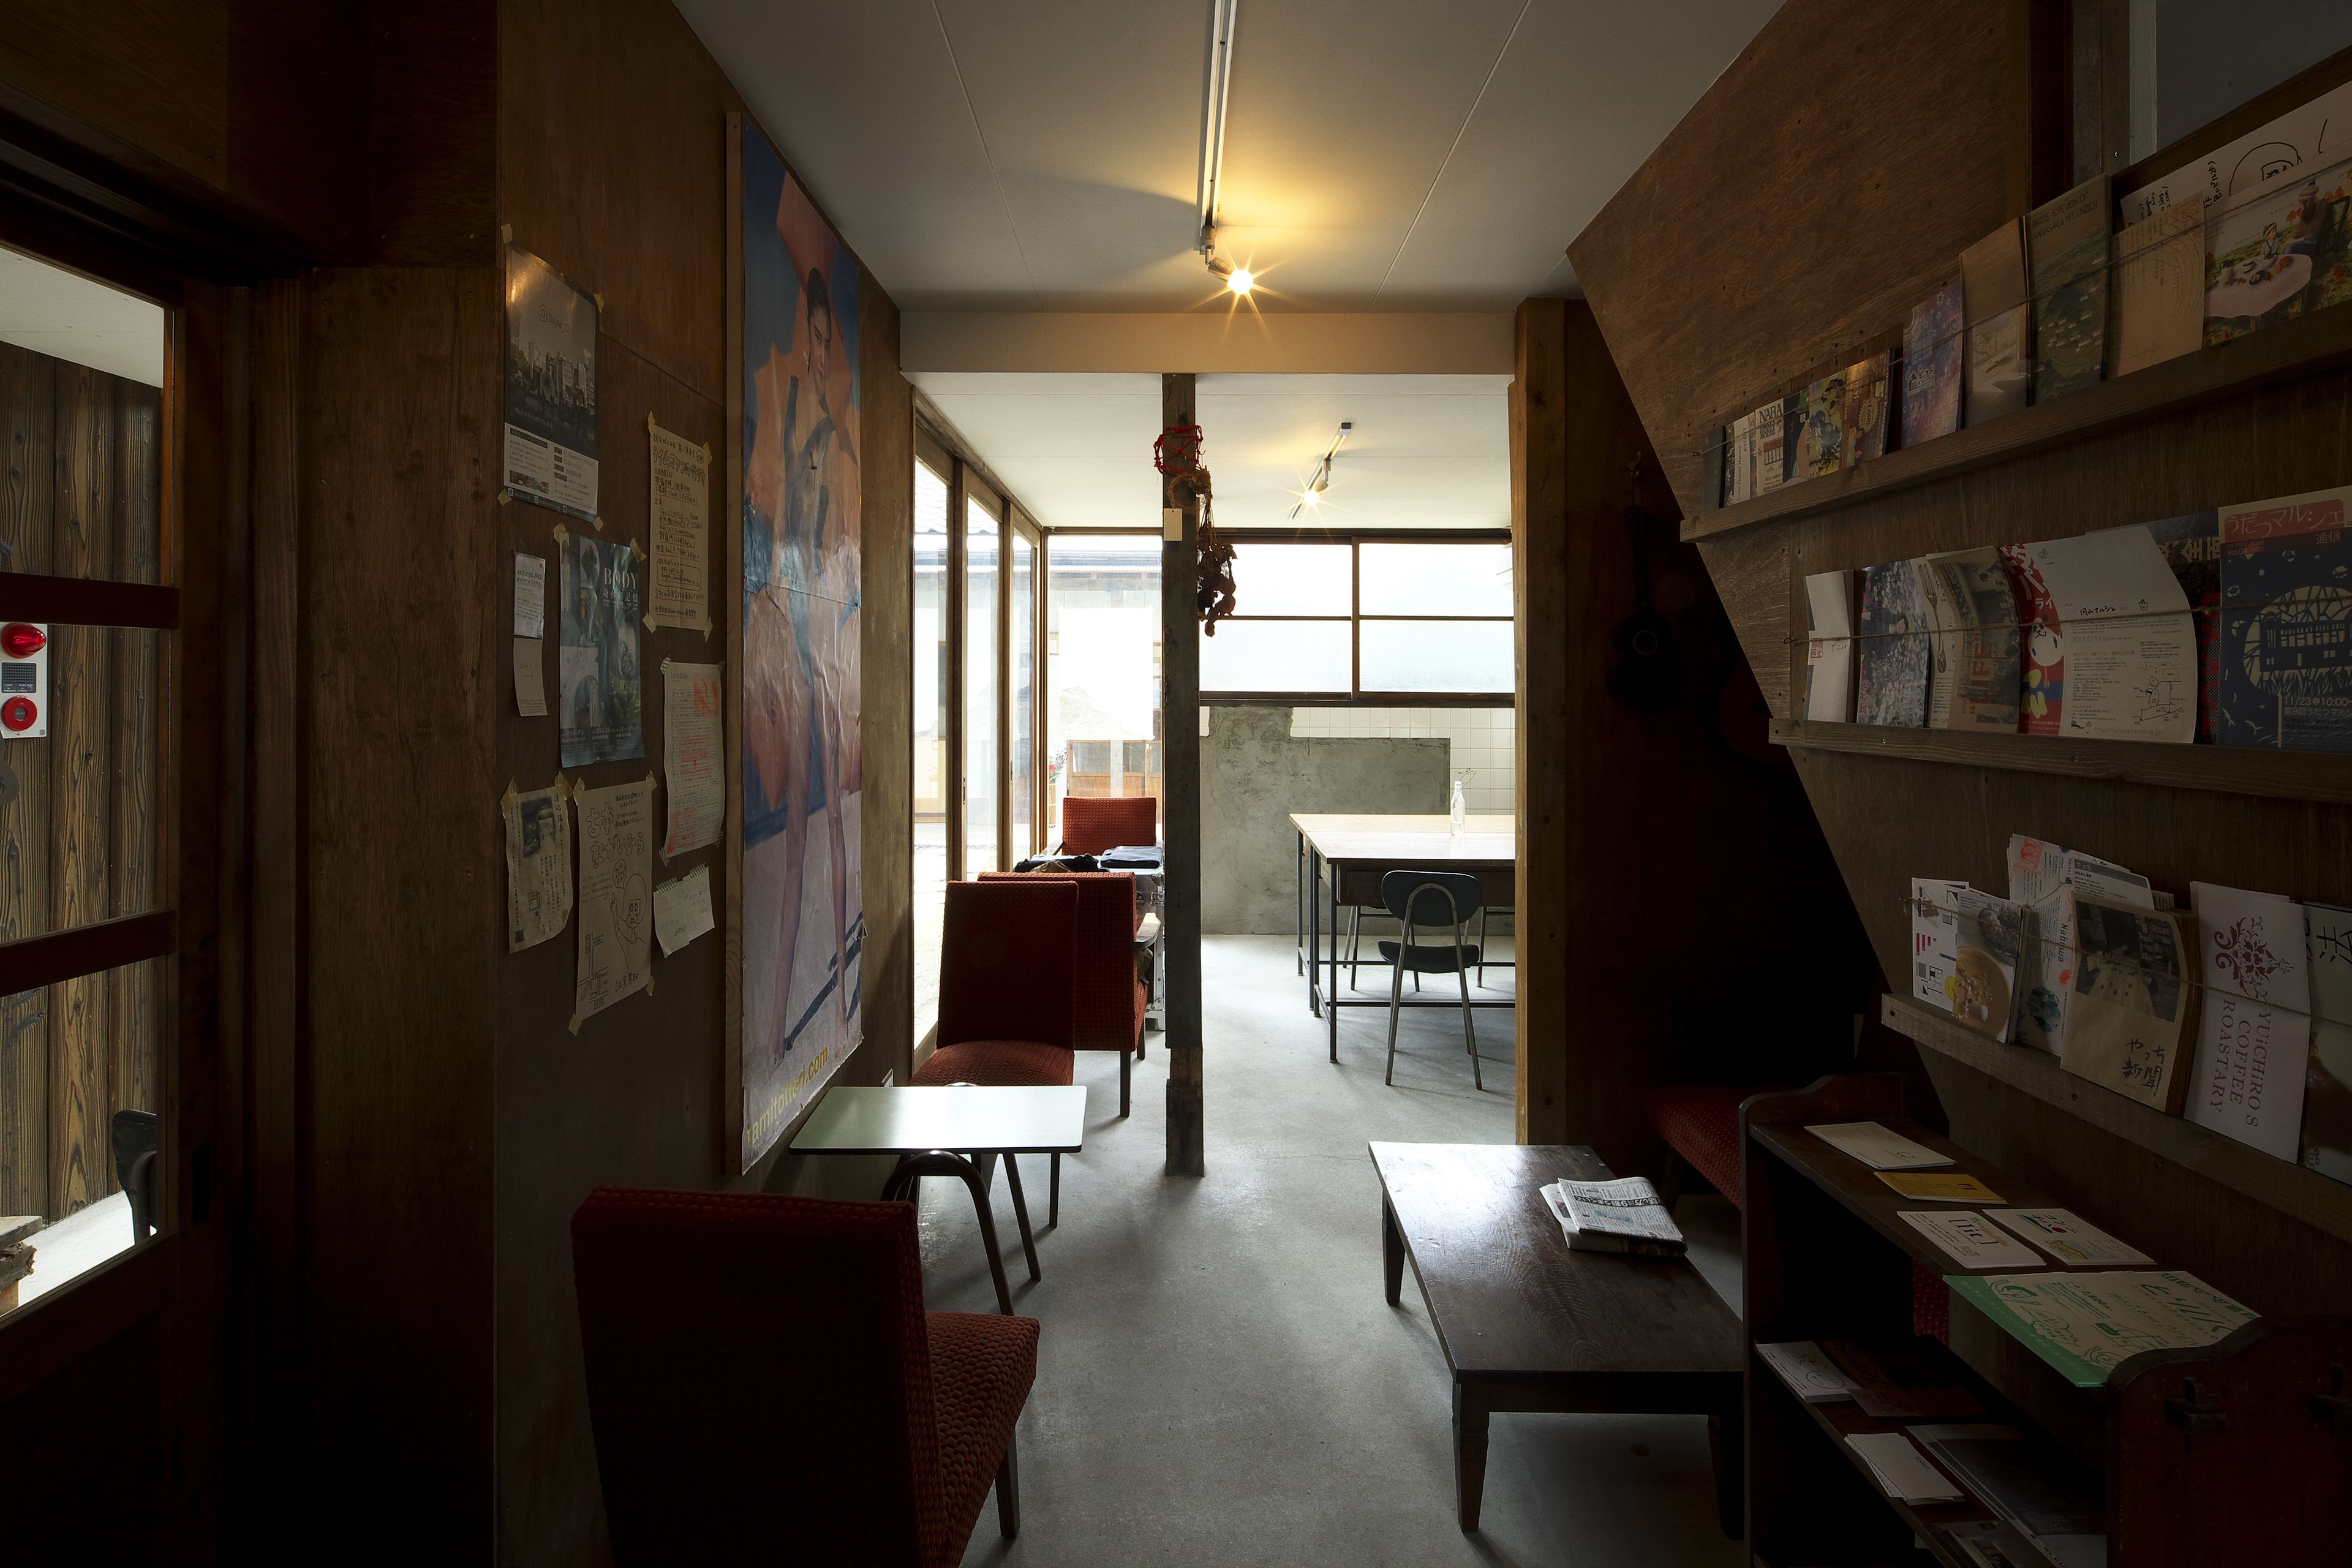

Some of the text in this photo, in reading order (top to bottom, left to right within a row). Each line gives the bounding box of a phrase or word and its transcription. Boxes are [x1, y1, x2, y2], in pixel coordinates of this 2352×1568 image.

[2032, 224, 2059, 240] NAGASAKI
[2077, 200, 2098, 217] UNZEN
[1759, 404, 1784, 423] NARA
[2225, 504, 2345, 538] うだつマルシェ
[2316, 530, 2341, 545] 通信
[603, 567, 638, 589] BODY
[2080, 605, 2116, 616] 円山マルシェ
[586, 802, 615, 839] 古本
[590, 832, 644, 870] ながいひる
[2126, 1038, 2166, 1064] やっち
[2209, 997, 2237, 1114] ROASTARY
[2229, 1020, 2252, 1104] COFFEE
[2121, 1057, 2163, 1097] 新聞
